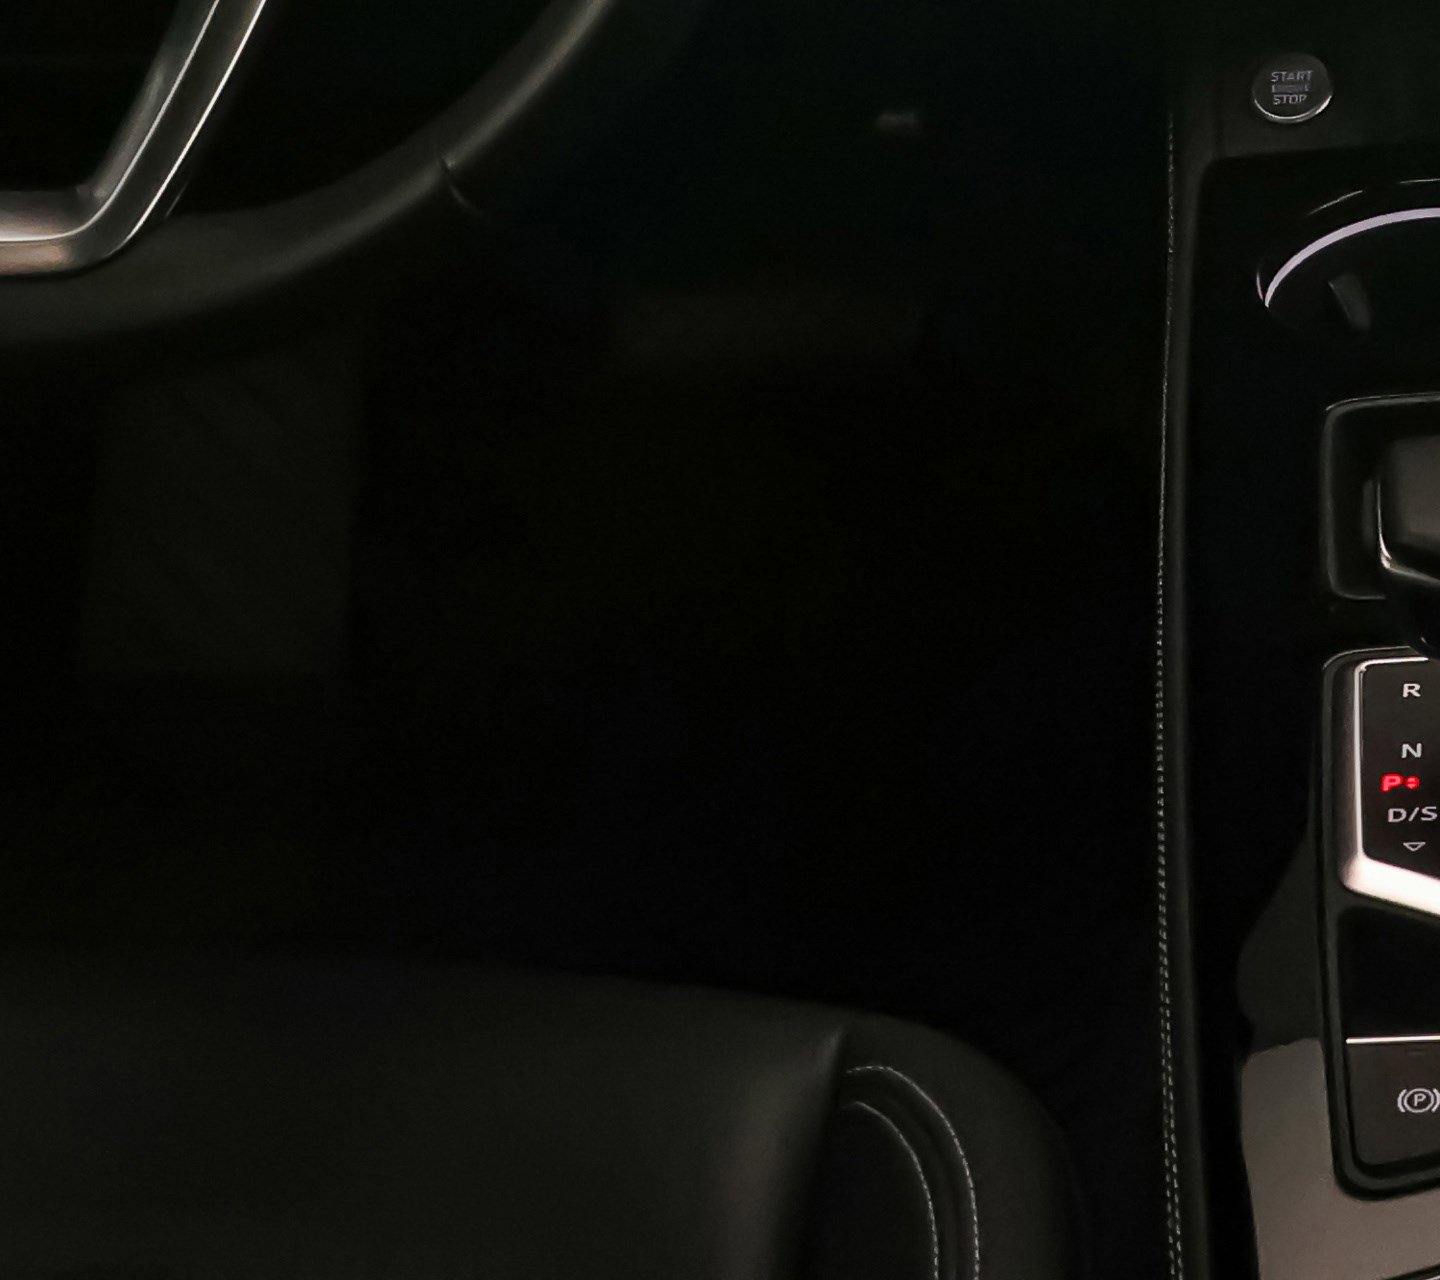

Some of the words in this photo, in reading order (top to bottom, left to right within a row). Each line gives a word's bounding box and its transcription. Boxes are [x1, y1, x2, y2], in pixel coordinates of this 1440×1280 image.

[1271, 70, 1313, 82] START
[1273, 94, 1307, 105] STOP
[1403, 684, 1421, 697] R
[1401, 743, 1422, 758] N
[1387, 807, 1437, 822] D/S
